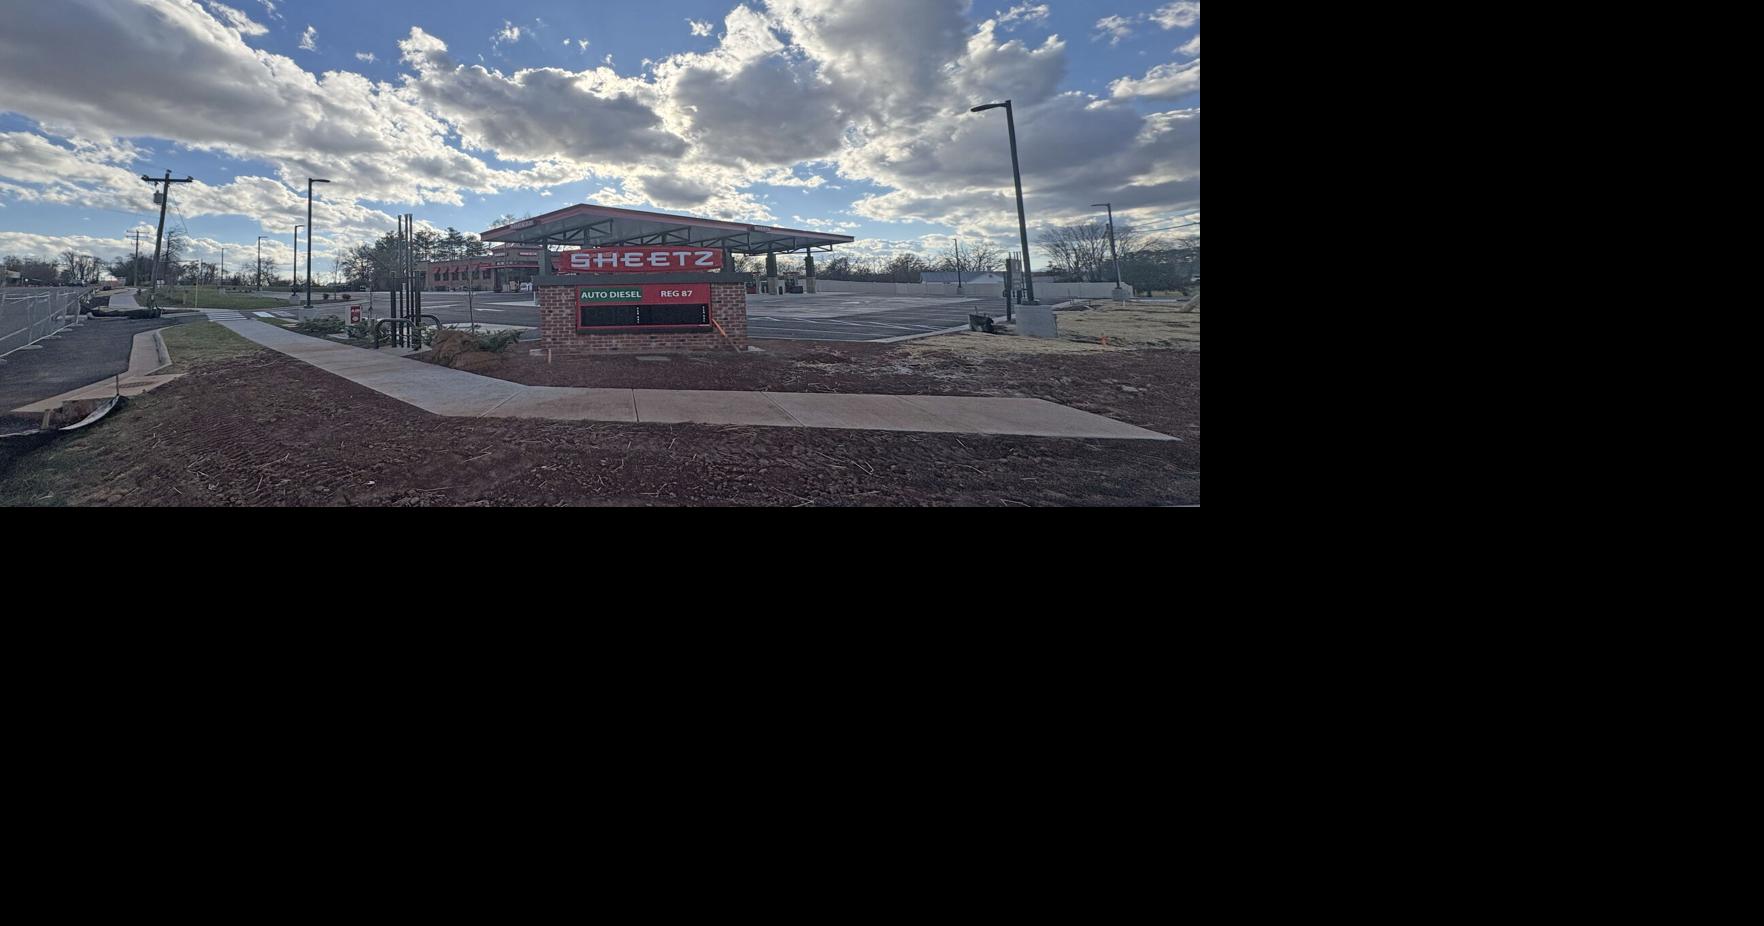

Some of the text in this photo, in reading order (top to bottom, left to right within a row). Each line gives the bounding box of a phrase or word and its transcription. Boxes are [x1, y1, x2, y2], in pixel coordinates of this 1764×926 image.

[571, 251, 714, 268] SHEETZ
[581, 291, 607, 299] AUTO
[660, 290, 679, 298] REG
